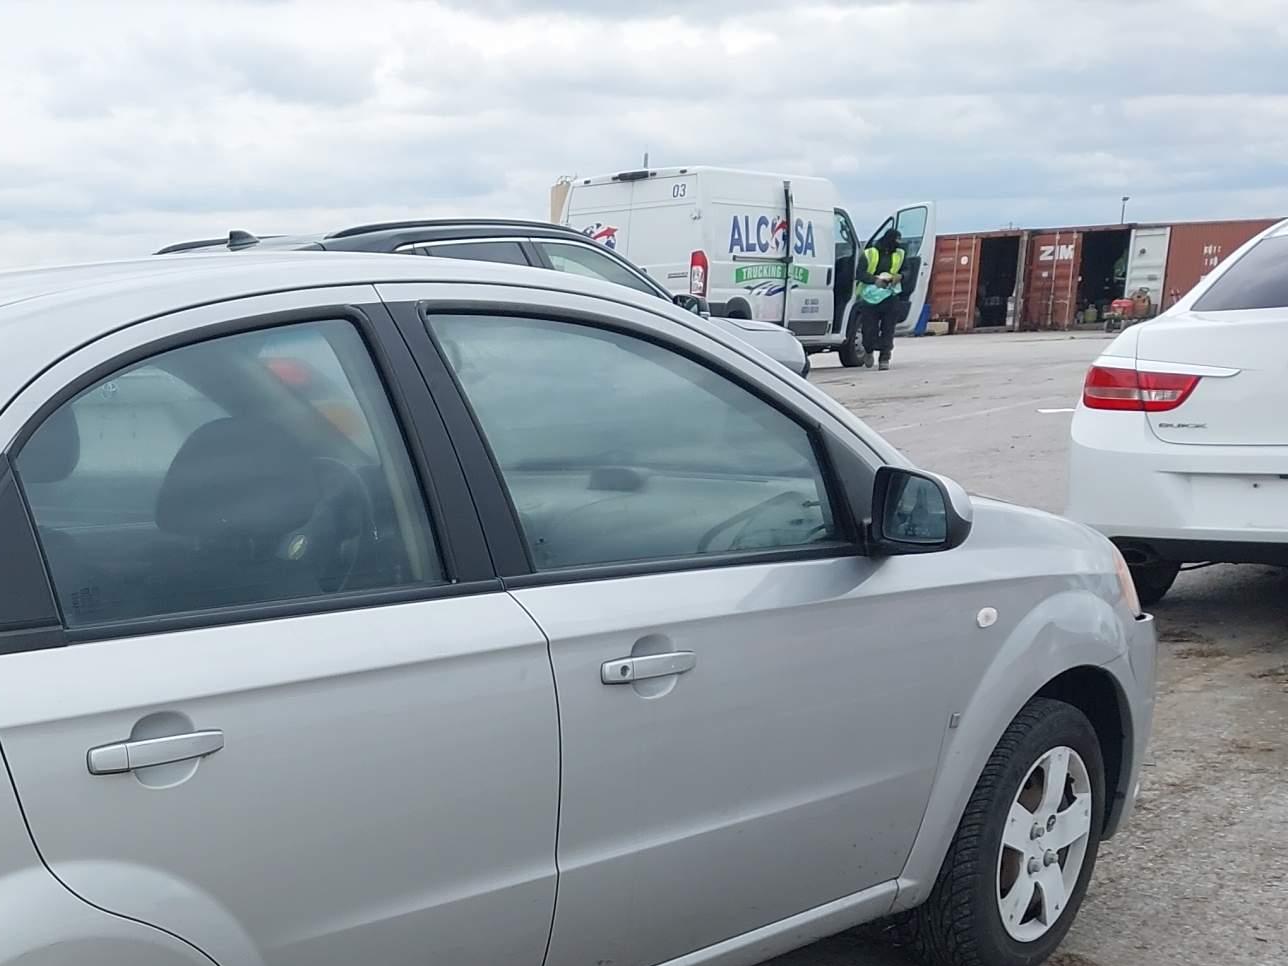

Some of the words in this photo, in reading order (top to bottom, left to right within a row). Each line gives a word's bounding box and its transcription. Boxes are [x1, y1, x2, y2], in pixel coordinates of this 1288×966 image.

[672, 183, 687, 198] 03
[1039, 244, 1076, 261] ZIM
[743, 264, 782, 281] TRUCKING
